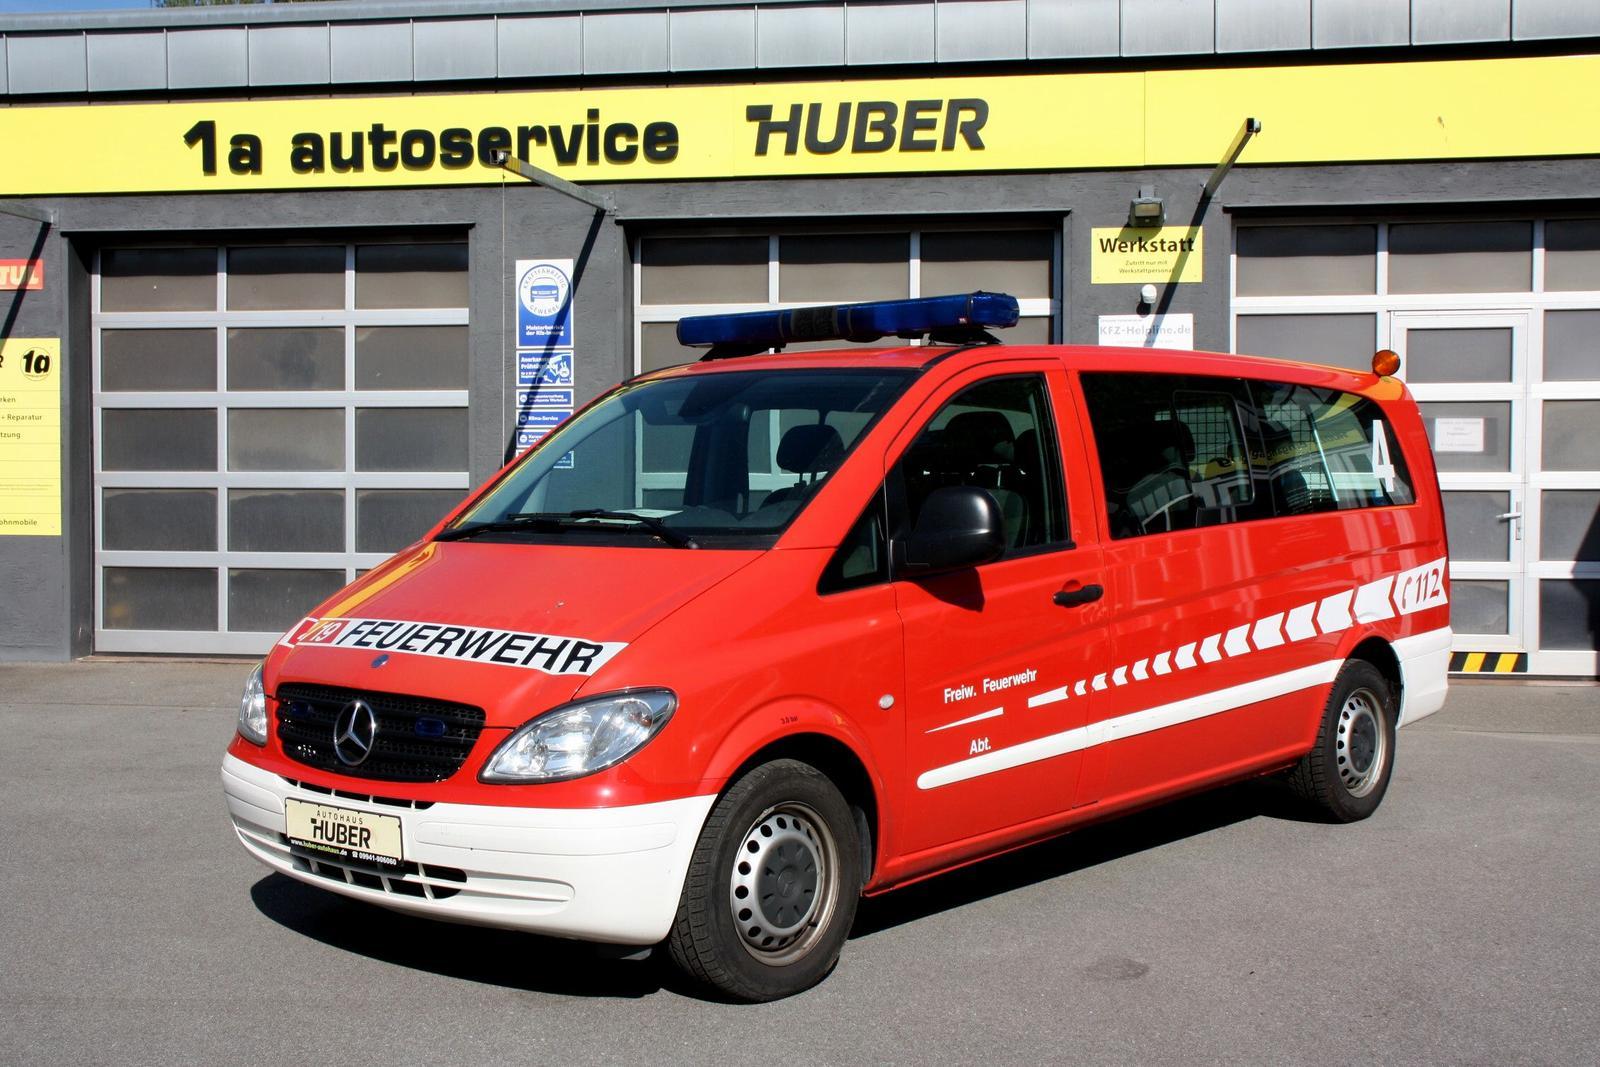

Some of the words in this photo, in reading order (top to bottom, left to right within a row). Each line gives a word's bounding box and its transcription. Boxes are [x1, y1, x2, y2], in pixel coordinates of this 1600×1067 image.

[183, 120, 263, 176] 1a
[290, 108, 680, 174] autoservice
[745, 98, 990, 157] HUBER
[1099, 236, 1195, 253] Werkstatt
[7, 413, 42, 422] Reparatur
[1415, 567, 1440, 605] 112
[335, 620, 604, 673] FEUERWEHR
[944, 684, 977, 704] Freiw.
[983, 668, 1038, 694] Feuerwehr
[969, 736, 992, 755] Abt.
[310, 817, 372, 849] HUBER
[316, 809, 364, 825] AUTOHAUS
